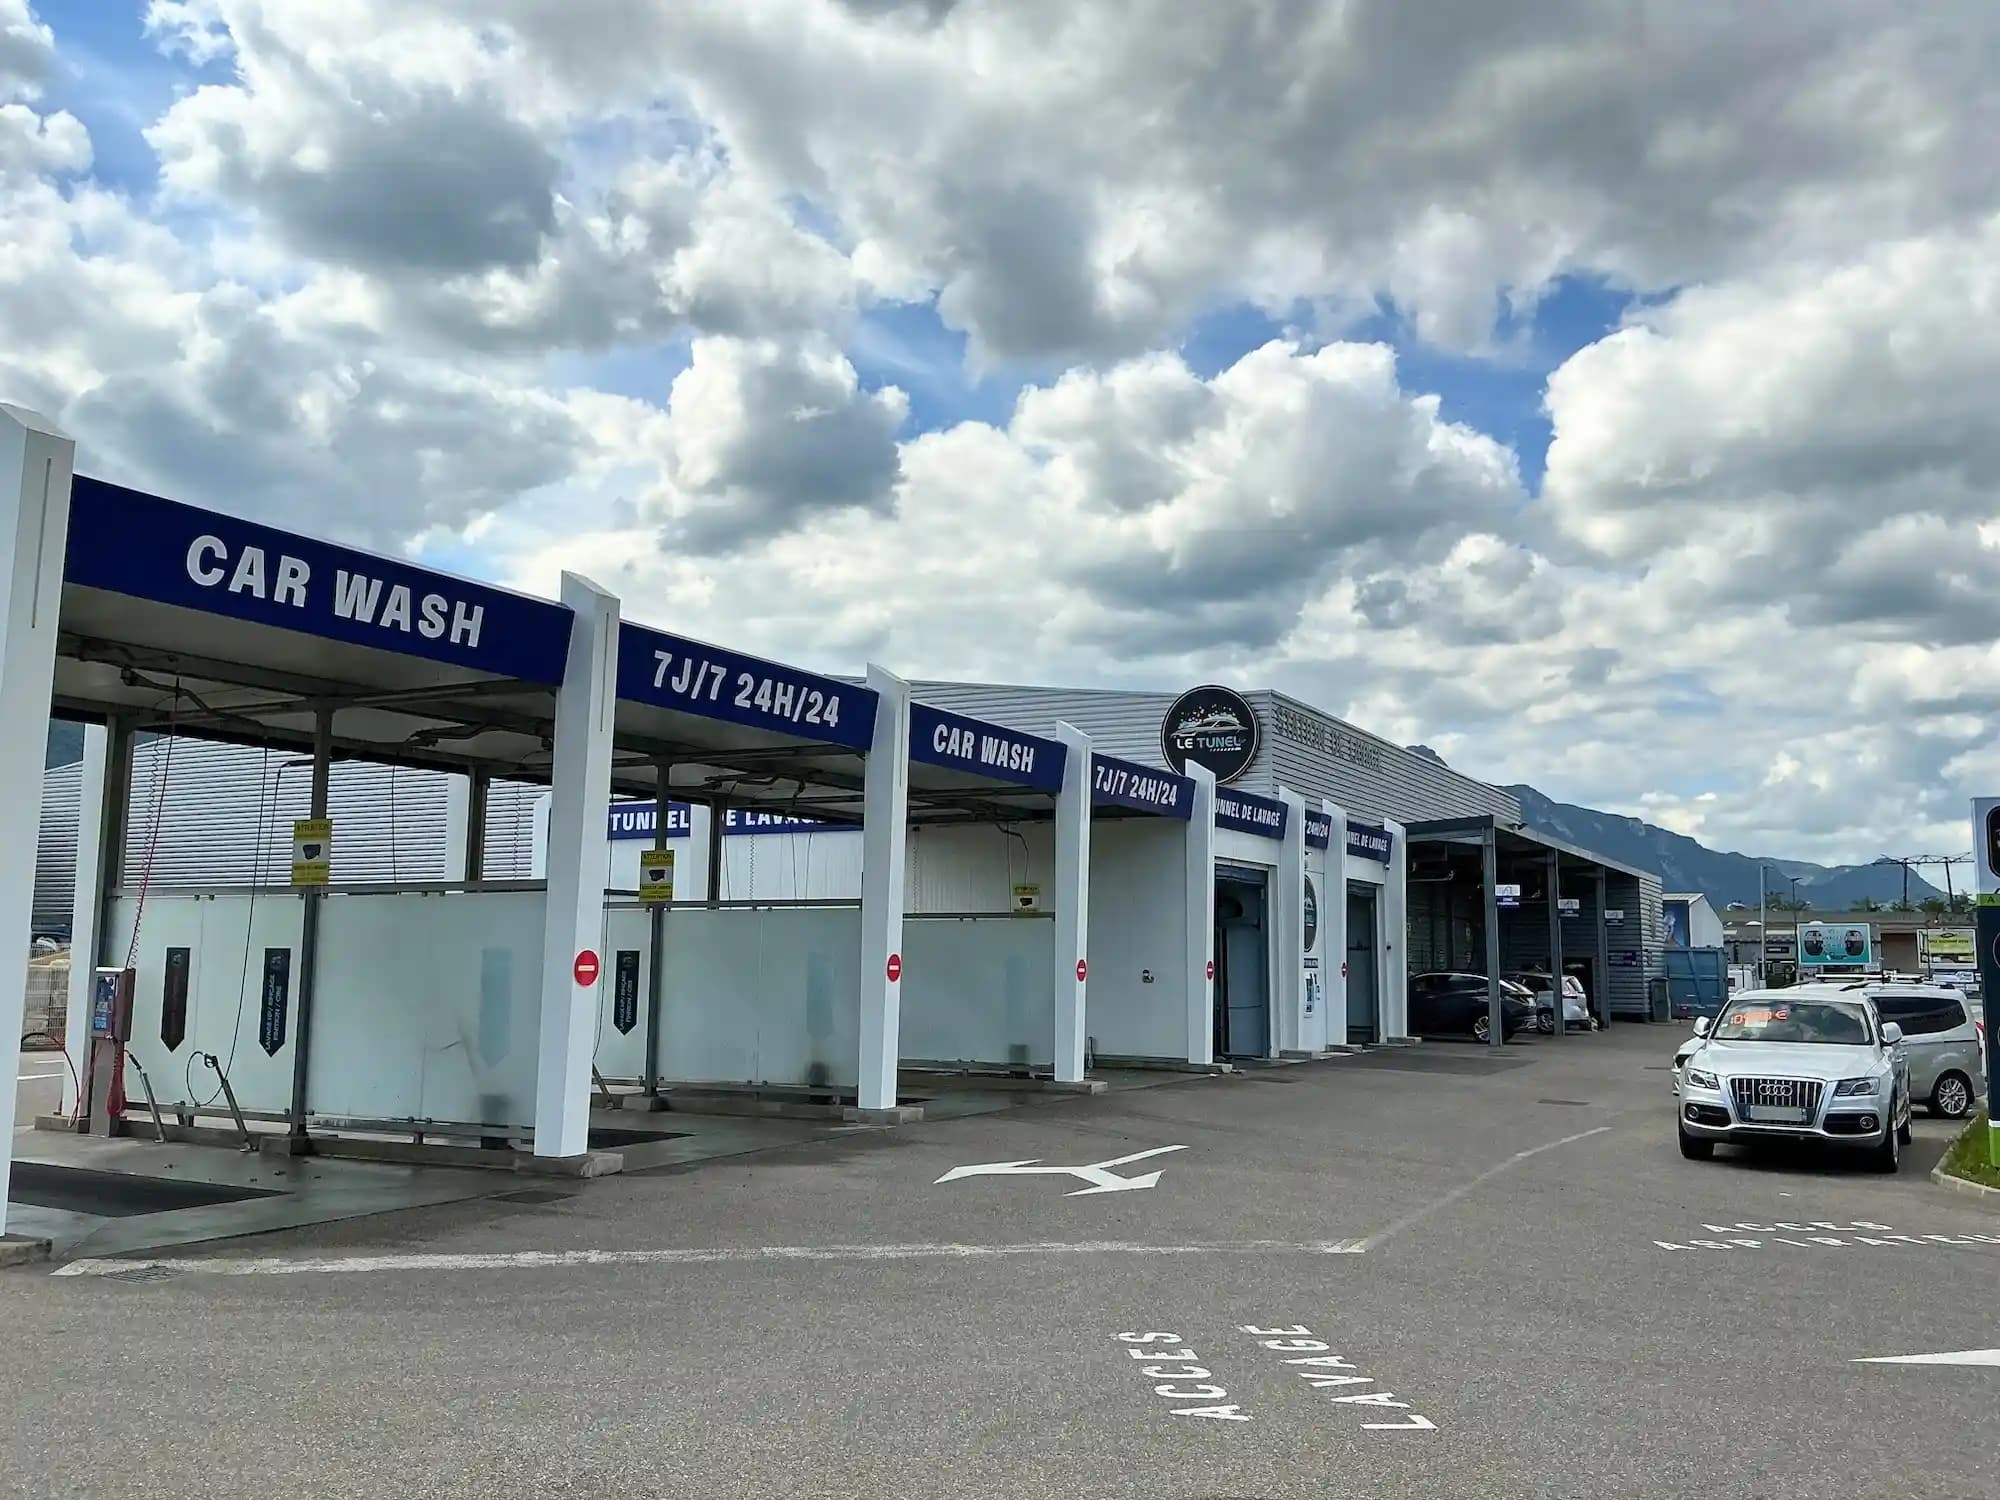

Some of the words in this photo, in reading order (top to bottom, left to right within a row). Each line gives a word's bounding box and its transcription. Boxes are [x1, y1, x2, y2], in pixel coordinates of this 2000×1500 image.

[186, 534, 311, 608] CAR
[334, 569, 485, 648] WASH
[653, 650, 727, 701] 7J/7
[734, 672, 841, 728] 24H/24
[933, 723, 975, 760] CAR
[980, 735, 1034, 774] WASH
[1176, 737, 1193, 750] LE
[1196, 736, 1242, 749] TUNEL
[1095, 765, 1128, 796] 7J/7
[1129, 774, 1178, 807] 24H/24
[721, 808, 737, 827] E
[1215, 797, 1240, 818] UNNEL
[1241, 804, 1253, 821] DE
[1253, 807, 1281, 827] LAVAGE
[1652, 1234, 2000, 1250] ASPIRATEU
[1700, 1221, 1893, 1233] ACCES
[1116, 1331, 1252, 1422] ACCES
[1242, 1324, 1437, 1431] LAVAGE
